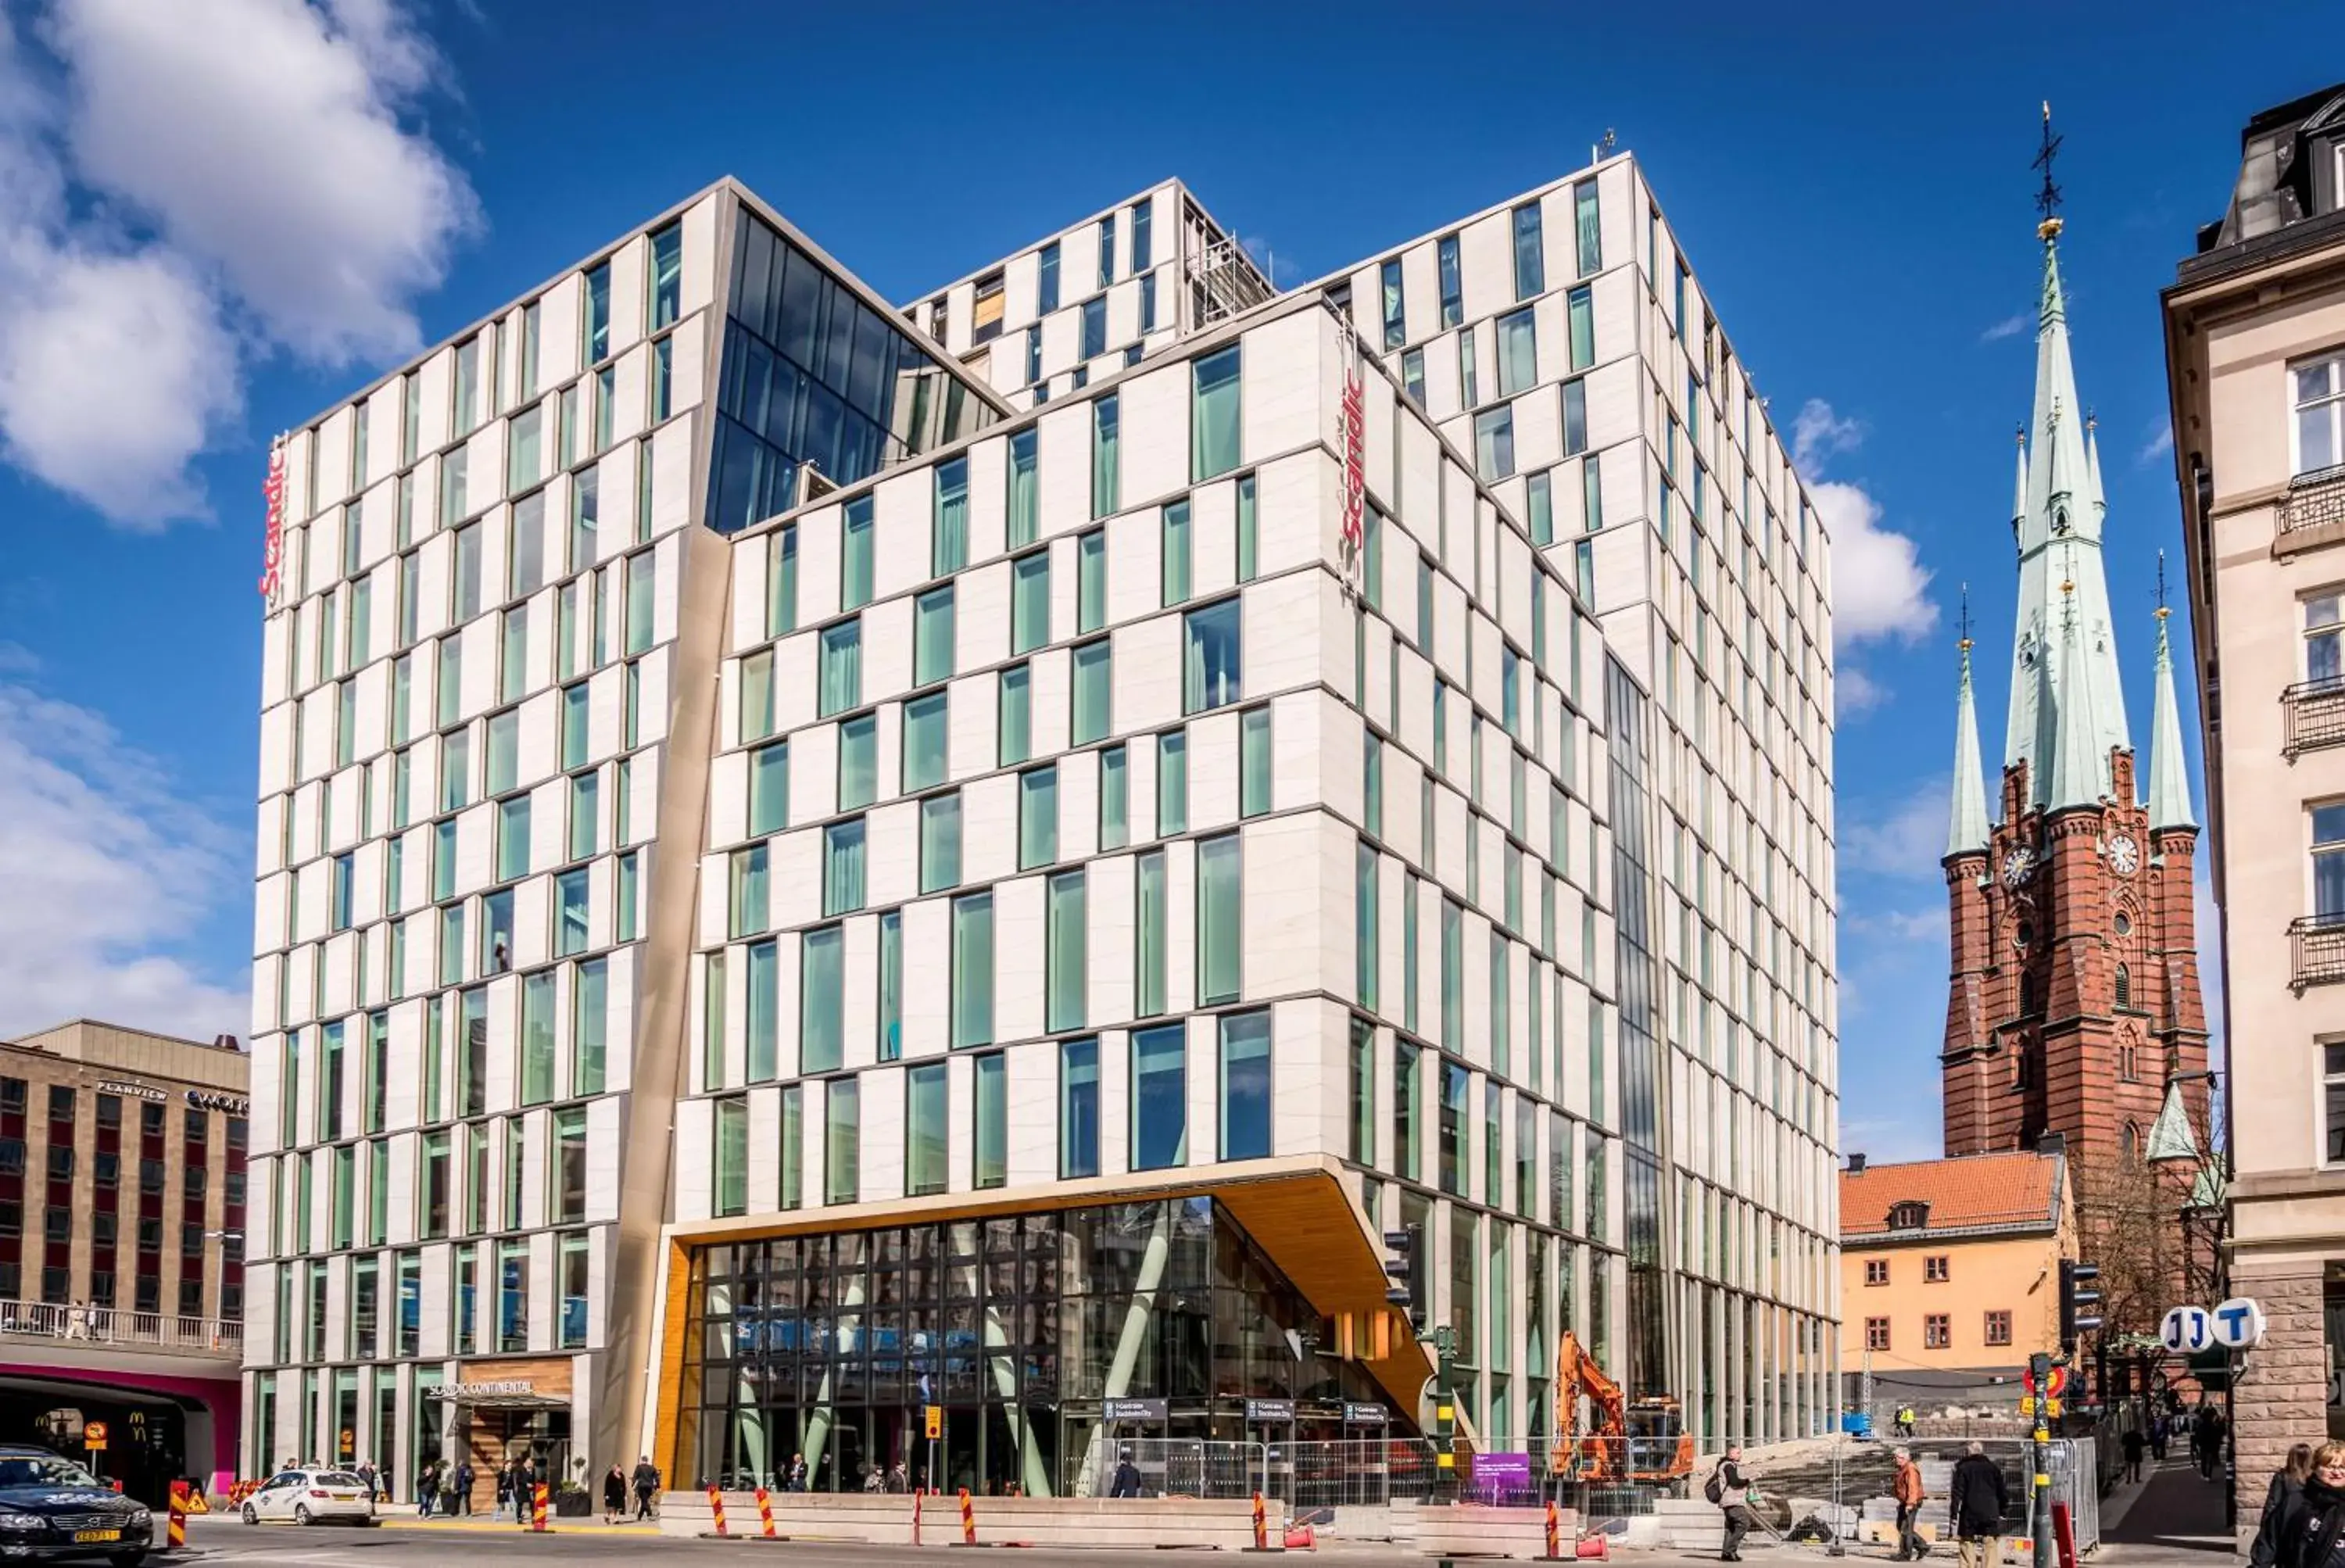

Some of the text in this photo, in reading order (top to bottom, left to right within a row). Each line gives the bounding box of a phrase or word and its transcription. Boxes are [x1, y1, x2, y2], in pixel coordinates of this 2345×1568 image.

[1343, 367, 1362, 550] Scandic
[258, 448, 285, 596] Scandic
[97, 1081, 168, 1101] PLANVIEW
[2218, 1307, 2249, 1342] T
